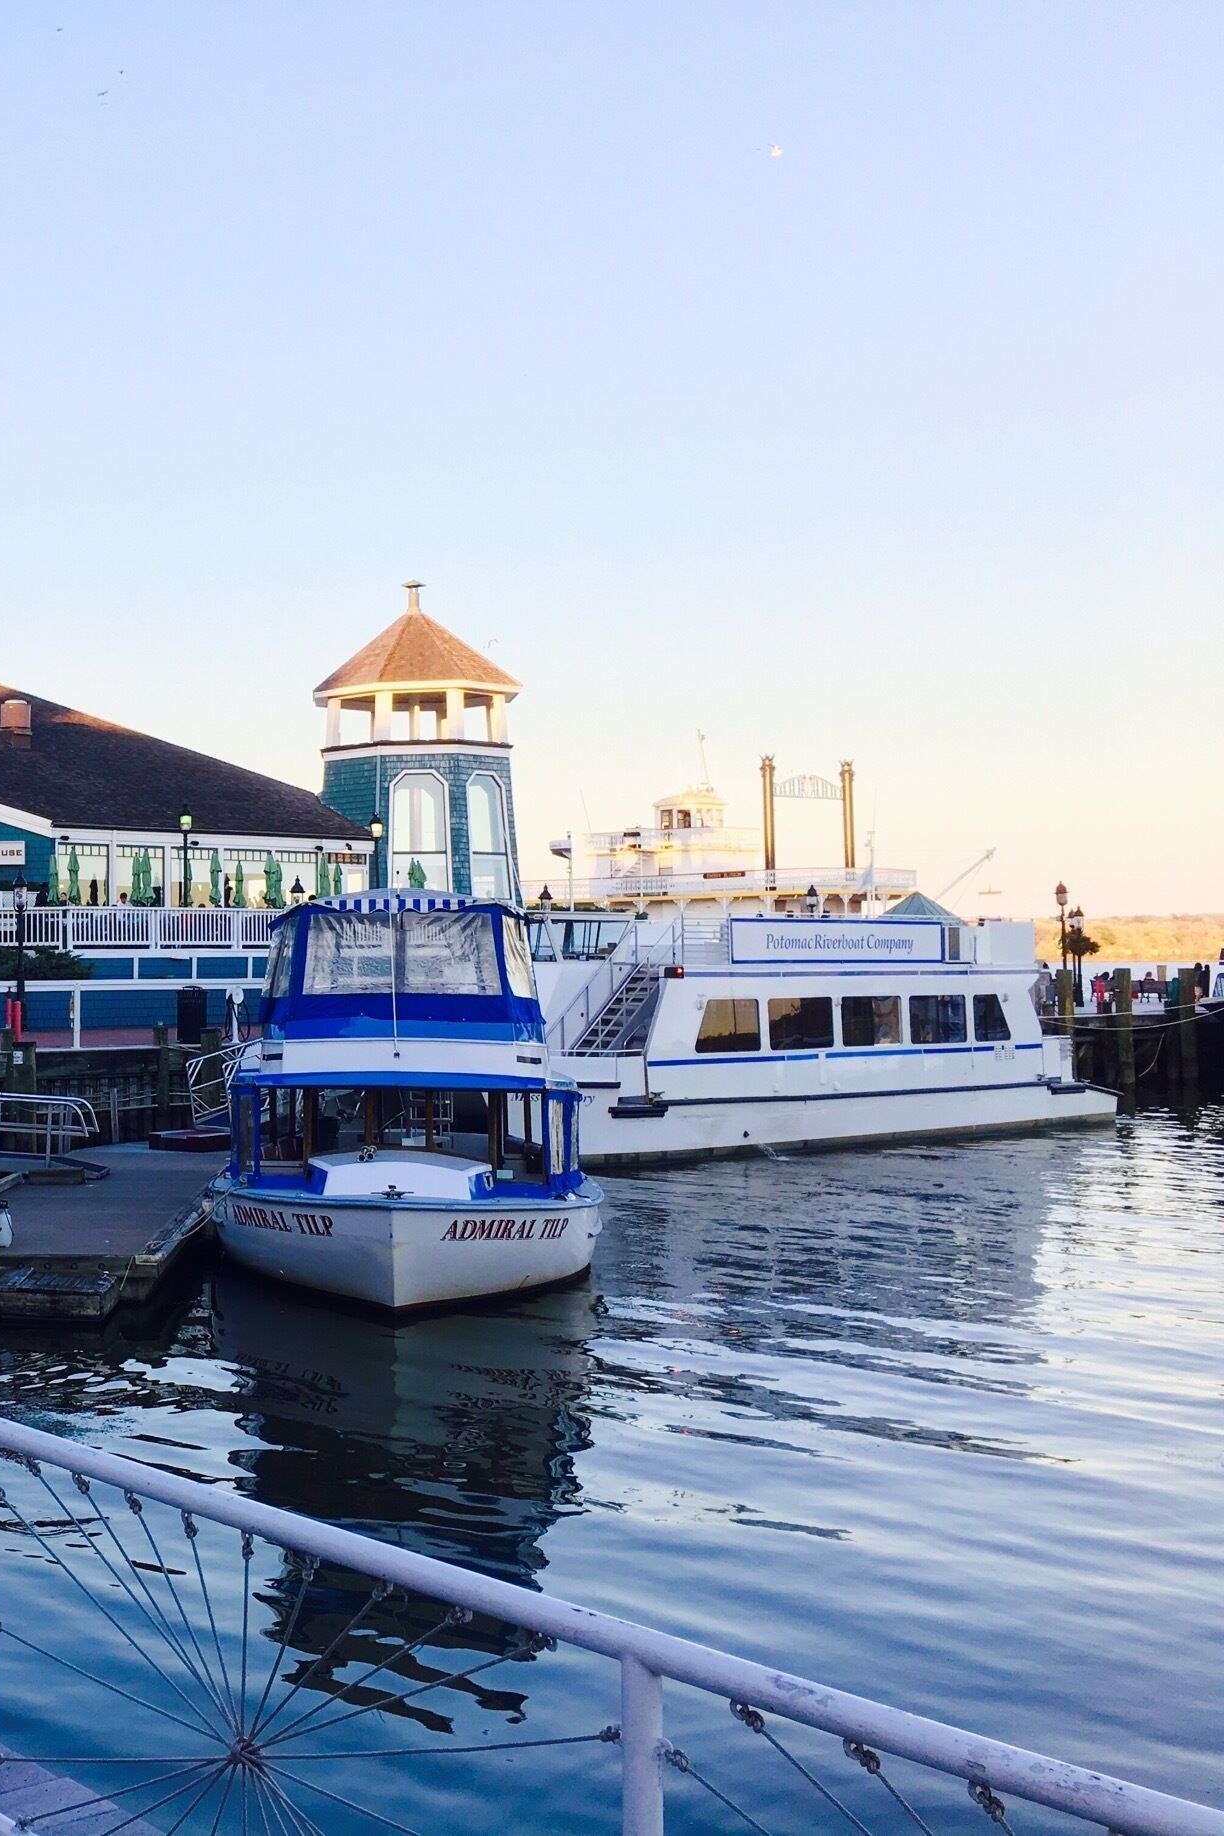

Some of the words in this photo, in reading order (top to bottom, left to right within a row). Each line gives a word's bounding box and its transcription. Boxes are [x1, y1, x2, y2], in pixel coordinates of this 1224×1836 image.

[766, 933, 813, 950] Potomac
[814, 933, 864, 950] Riverboat
[866, 933, 914, 955] Company
[292, 1212, 334, 1237] TILP
[440, 1219, 537, 1241] ADMIRAL
[537, 1217, 569, 1240] TILP
